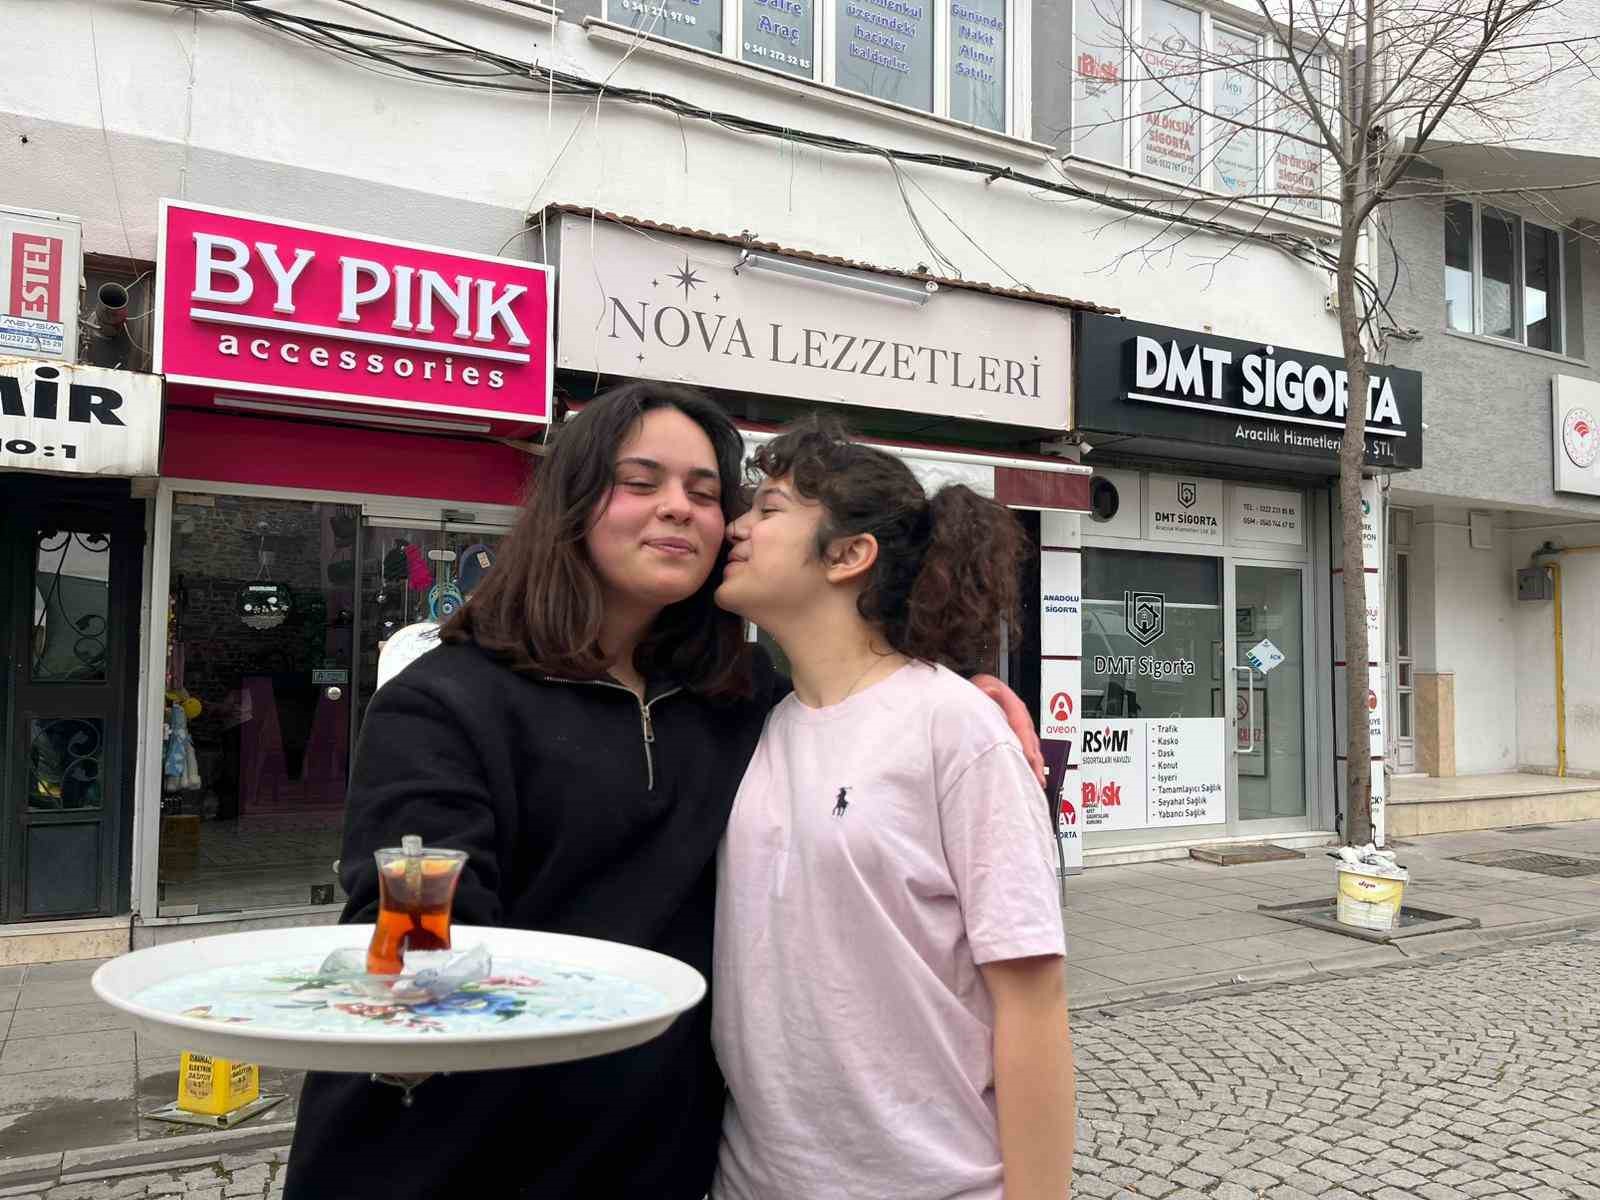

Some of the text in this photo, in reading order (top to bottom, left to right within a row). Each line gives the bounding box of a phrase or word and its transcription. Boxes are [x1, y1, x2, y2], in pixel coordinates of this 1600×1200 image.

[959, 24, 995, 47] Nakit
[21, 234, 51, 320] ESTEL
[191, 230, 532, 346] BY PINK
[606, 296, 1044, 400] NOVA LEZZETLERİ
[217, 333, 506, 390] accessories
[1134, 335, 1233, 400] DMT
[1235, 424, 1280, 443] Aracılık
[1154, 511, 1218, 527] DMT SİGORTA
[1043, 594, 1080, 602] ANADOLU
[1045, 604, 1078, 614] SİGORTA
[1094, 655, 1195, 679] DMT Sigorta
[1046, 725, 1077, 734] aveon
[1157, 724, 1179, 733] Trafik
[1082, 726, 1129, 753] RSİM
[1157, 737, 1179, 746] Kasko
[1157, 749, 1175, 758] Dask
[1157, 761, 1178, 770] Konut
[1158, 797, 1185, 807] Seyahat
[1060, 811, 1076, 825] AY
[1158, 810, 1184, 818] Yabancı
[1058, 831, 1077, 839] ORTA
